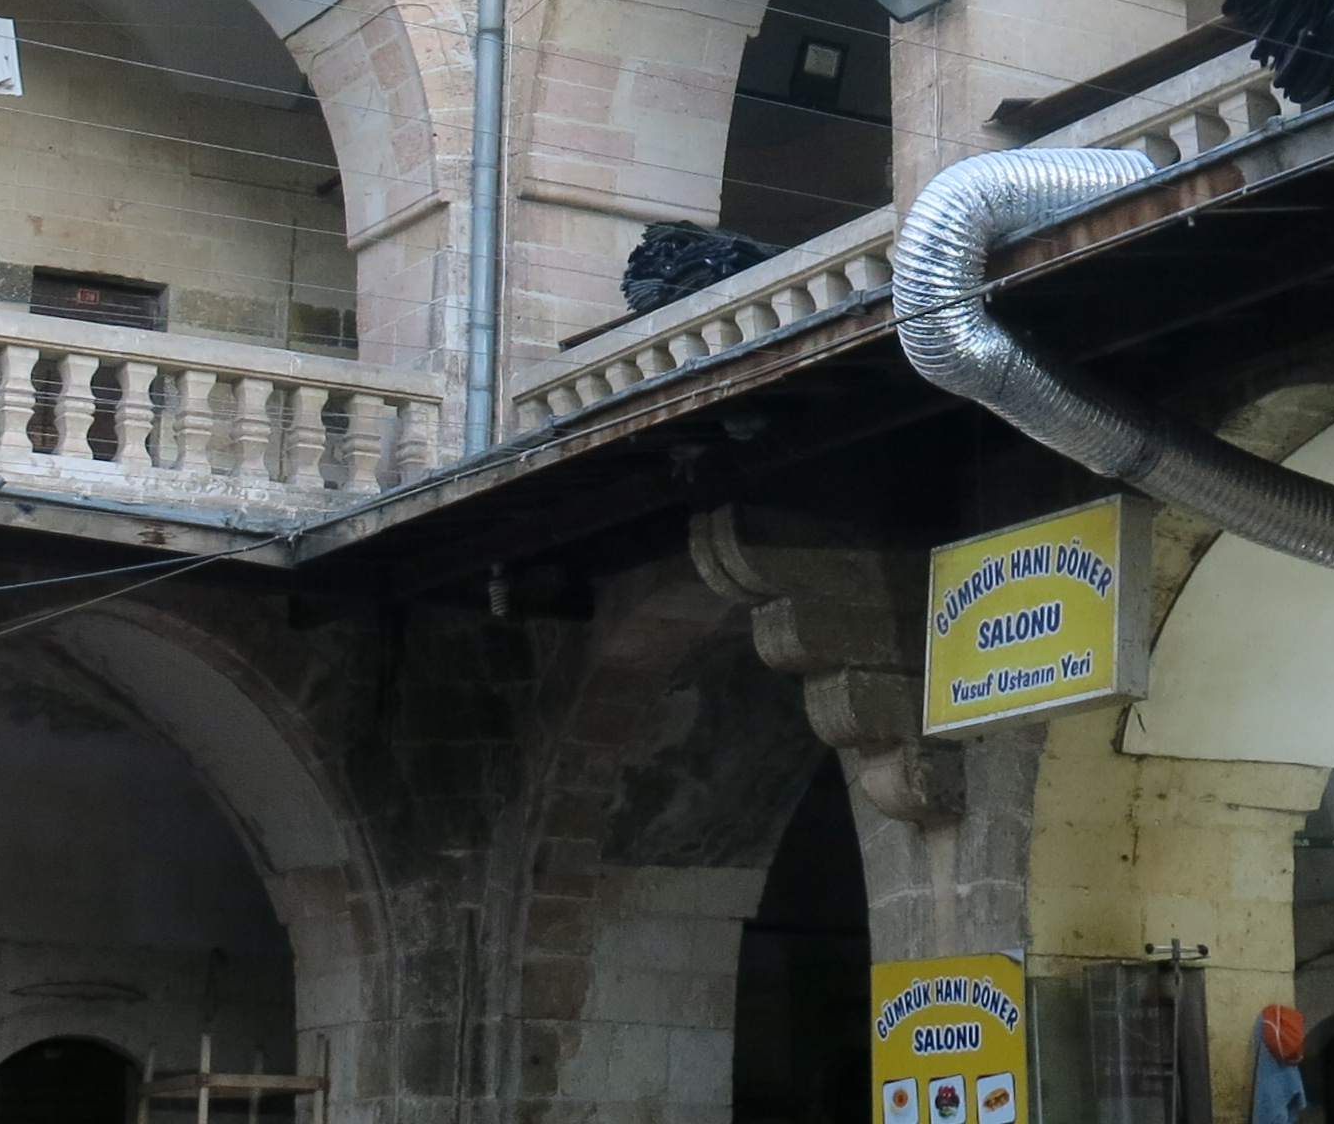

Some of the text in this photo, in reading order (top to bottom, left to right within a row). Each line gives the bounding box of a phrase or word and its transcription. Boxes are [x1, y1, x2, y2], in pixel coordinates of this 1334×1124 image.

[936, 538, 1113, 635] GÜMRÜK HANI DÖNER
[977, 602, 1061, 650] SALONU
[951, 651, 1091, 704] Yusuf Ustanın Yeri
[876, 977, 1019, 1039] GÜMRÜK HANI DÖNER
[913, 1024, 980, 1052] SALONU
